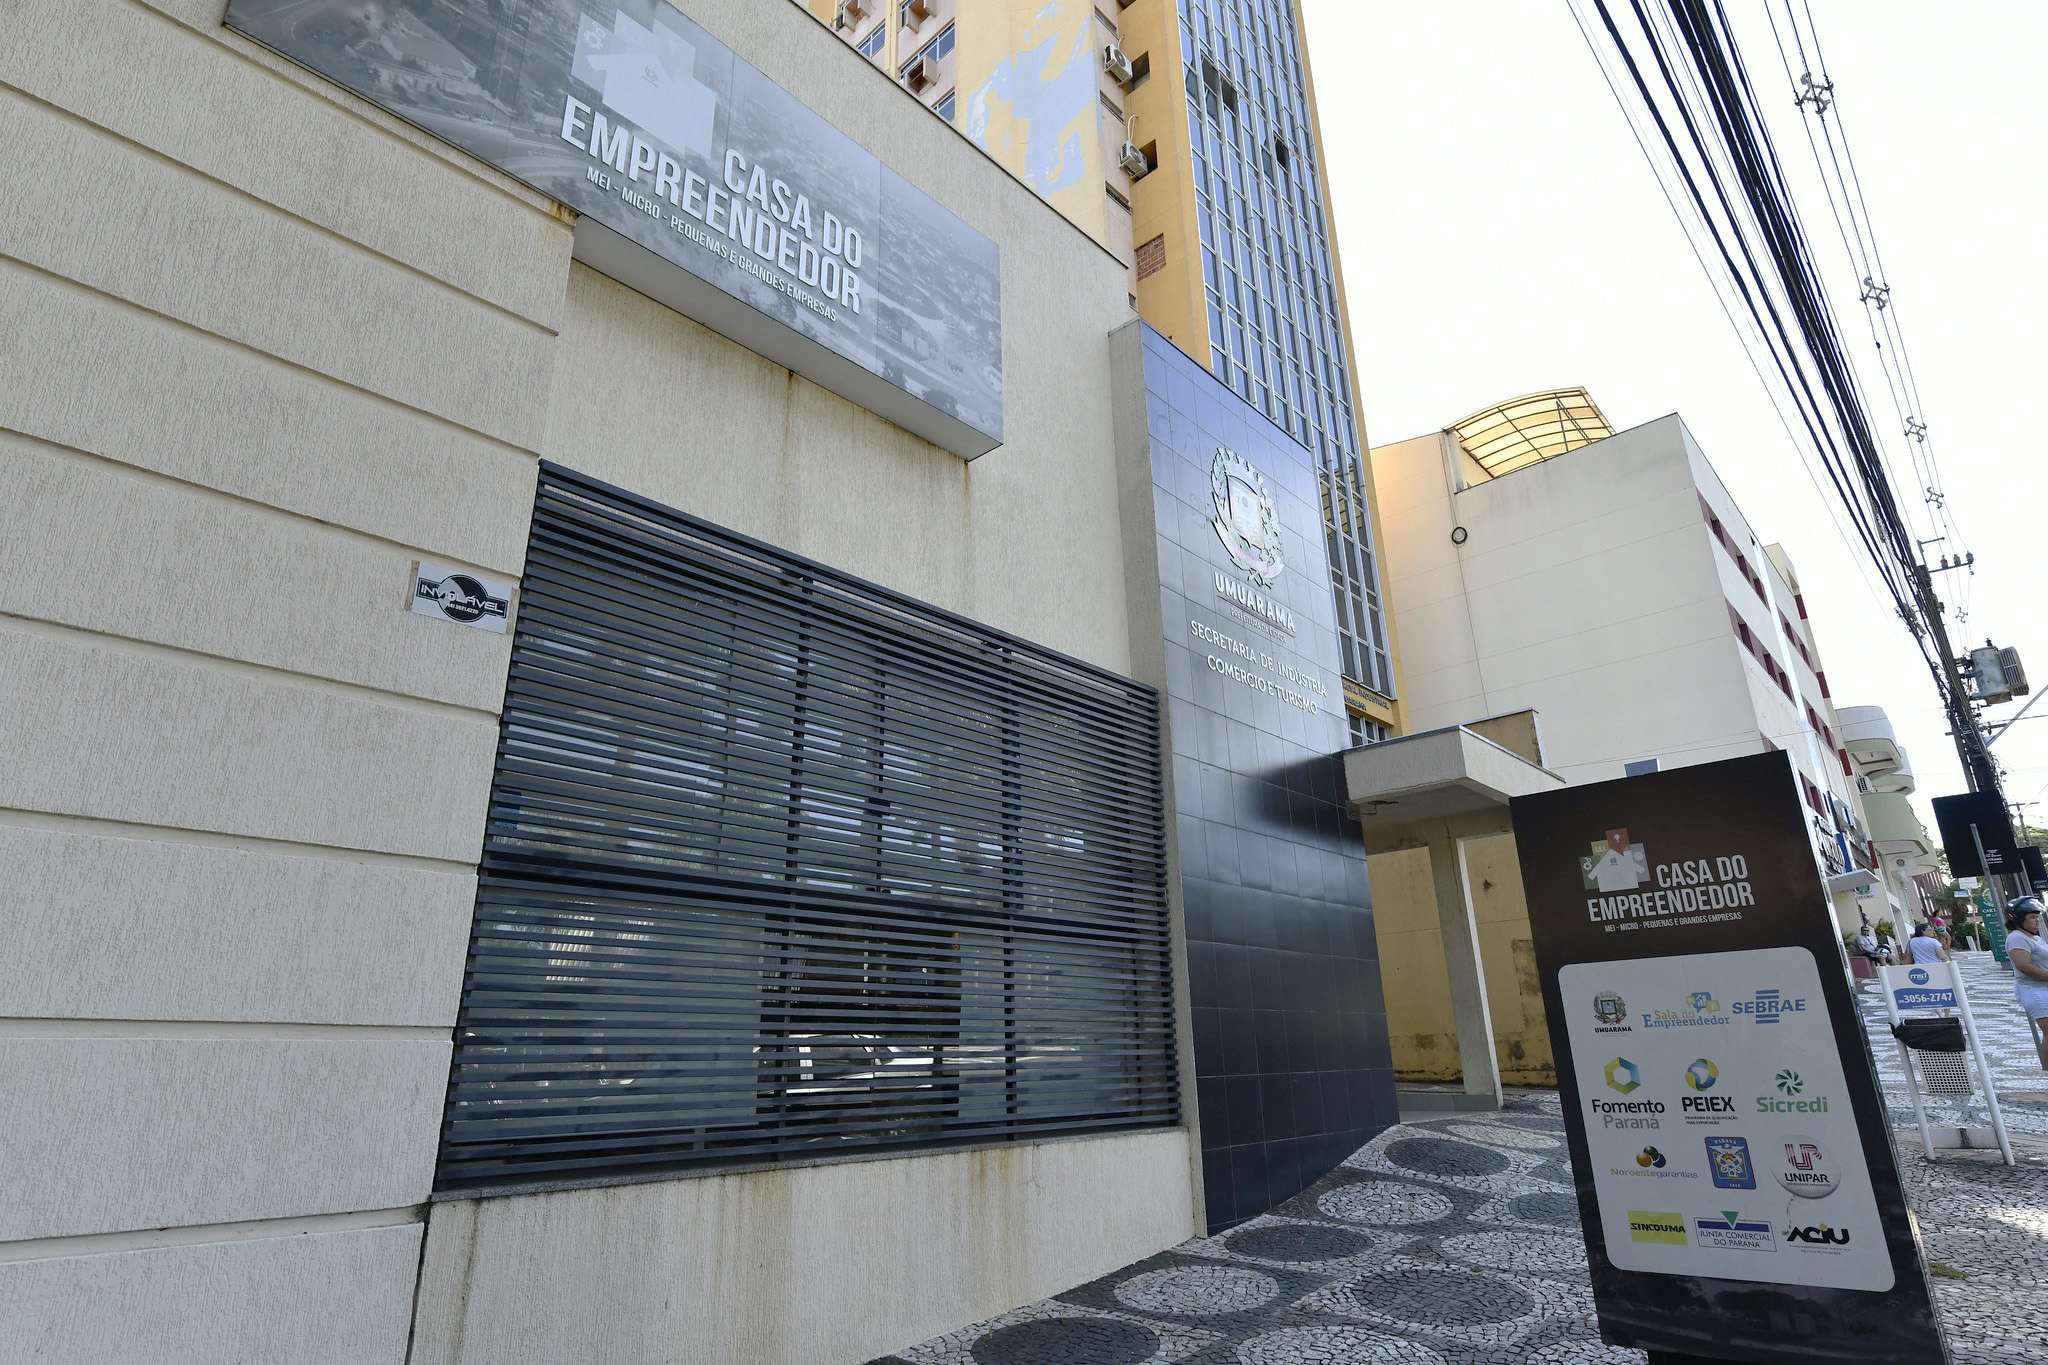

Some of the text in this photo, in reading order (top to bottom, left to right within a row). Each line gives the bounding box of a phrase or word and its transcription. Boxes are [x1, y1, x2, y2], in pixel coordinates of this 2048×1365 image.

[561, 94, 861, 315] EMPREENDEDOR
[724, 148, 862, 269] CASA DO
[586, 166, 611, 191] MEI
[621, 186, 660, 220] MICRO
[671, 215, 728, 259] PEQUENAS
[729, 248, 736, 266] E
[738, 255, 785, 293] GRANDES
[787, 283, 837, 322] EMPRESAS
[1214, 572, 1297, 633] UMUARAMA
[1190, 620, 1328, 698] SECRETARIA DE INDÚSTRIA
[1207, 653, 1319, 716] COMÉRCIO E TURISMO
[1655, 854, 1748, 889] CASA DO
[1587, 881, 1755, 922] EMPREENDEDOR
[1604, 924, 1616, 933] MEI
[1620, 921, 1639, 931] MICRO
[1643, 917, 1674, 929] PEQUENAS
[1674, 917, 1679, 926] E
[1679, 914, 1708, 925] GRANDES
[1708, 911, 1742, 923] EMPRESAS
[1732, 998, 1806, 1015] SEBRAE
[1903, 992, 1952, 1004] 3056-2747
[1642, 1013, 1730, 1029] Empreendedor
[1654, 1008, 1695, 1020] Sala do
[1594, 1026, 1633, 1034] UMUARAMA
[1592, 1098, 1665, 1114] Fomento
[1681, 1096, 1735, 1113] PEIEX
[1756, 1096, 1828, 1113] Sicredi
[1603, 1113, 1660, 1130] Paraná
[1611, 1168, 1699, 1180] Noroestegarantias
[1784, 1172, 1830, 1184] UNIPAR
[1630, 1222, 1686, 1233] SINCOUMA
[1699, 1230, 1772, 1242] JUNTA COMERCIAL
[1713, 1238, 1726, 1246] DO
